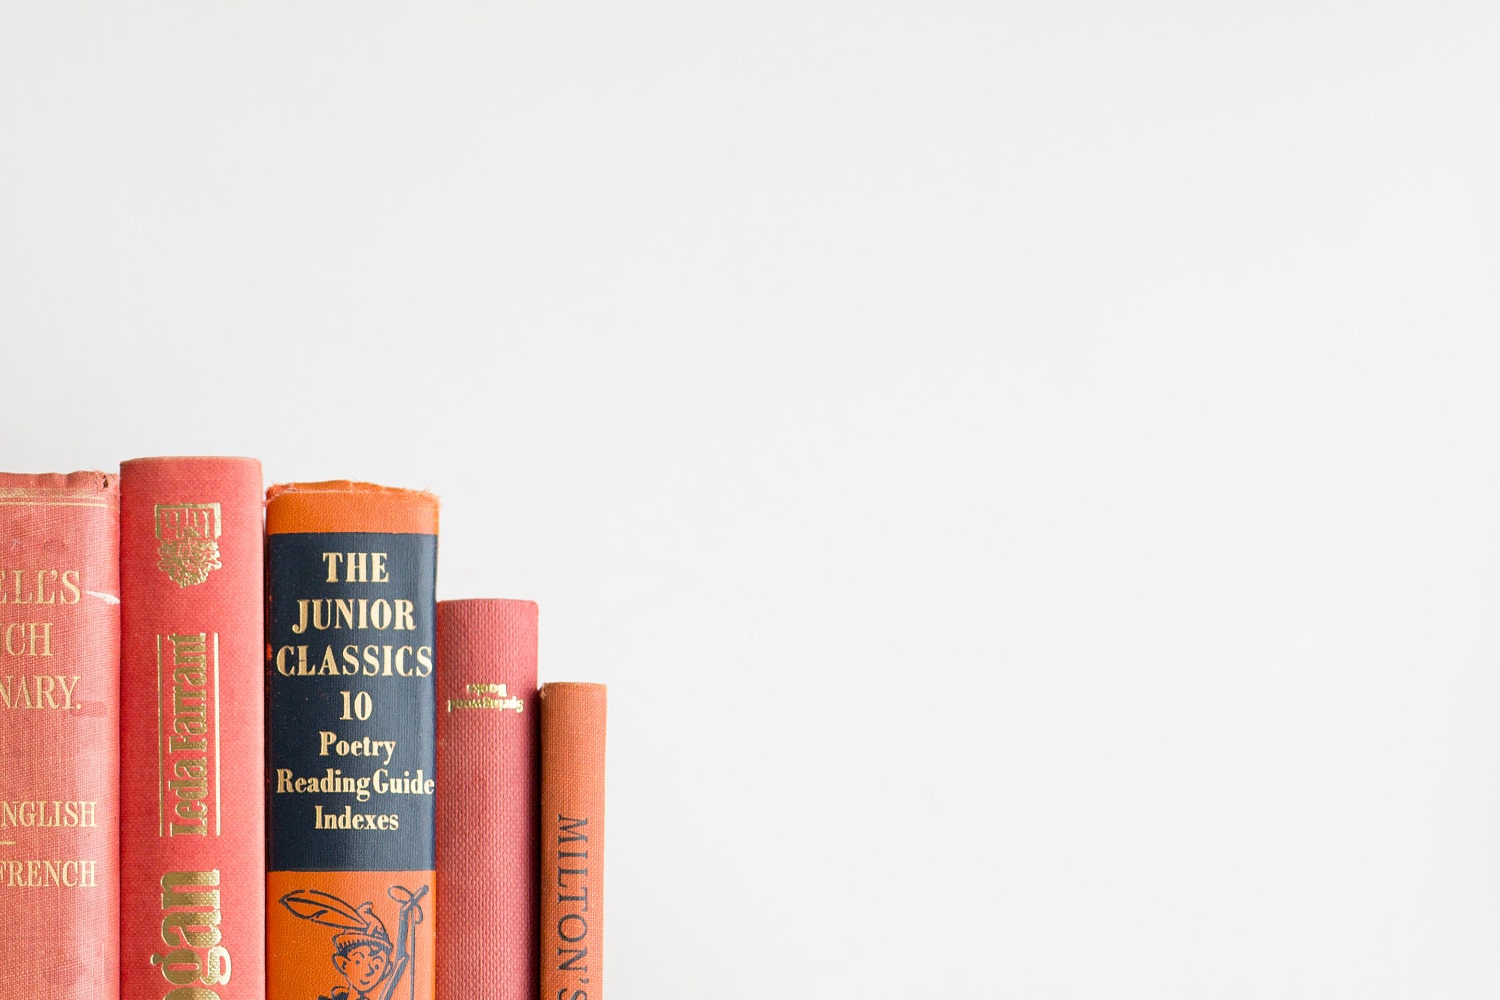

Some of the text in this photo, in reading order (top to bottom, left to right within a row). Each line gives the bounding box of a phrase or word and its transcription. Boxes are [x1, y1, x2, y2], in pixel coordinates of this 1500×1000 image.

[322, 552, 390, 584] THE
[292, 598, 417, 634] JUNIOR
[275, 644, 434, 678] CLASSICS
[339, 690, 373, 721] 10
[167, 631, 209, 837] Leda Farrant
[318, 731, 397, 765] Poetry
[276, 768, 435, 802] Reading Guide
[314, 805, 400, 831] Indexes
